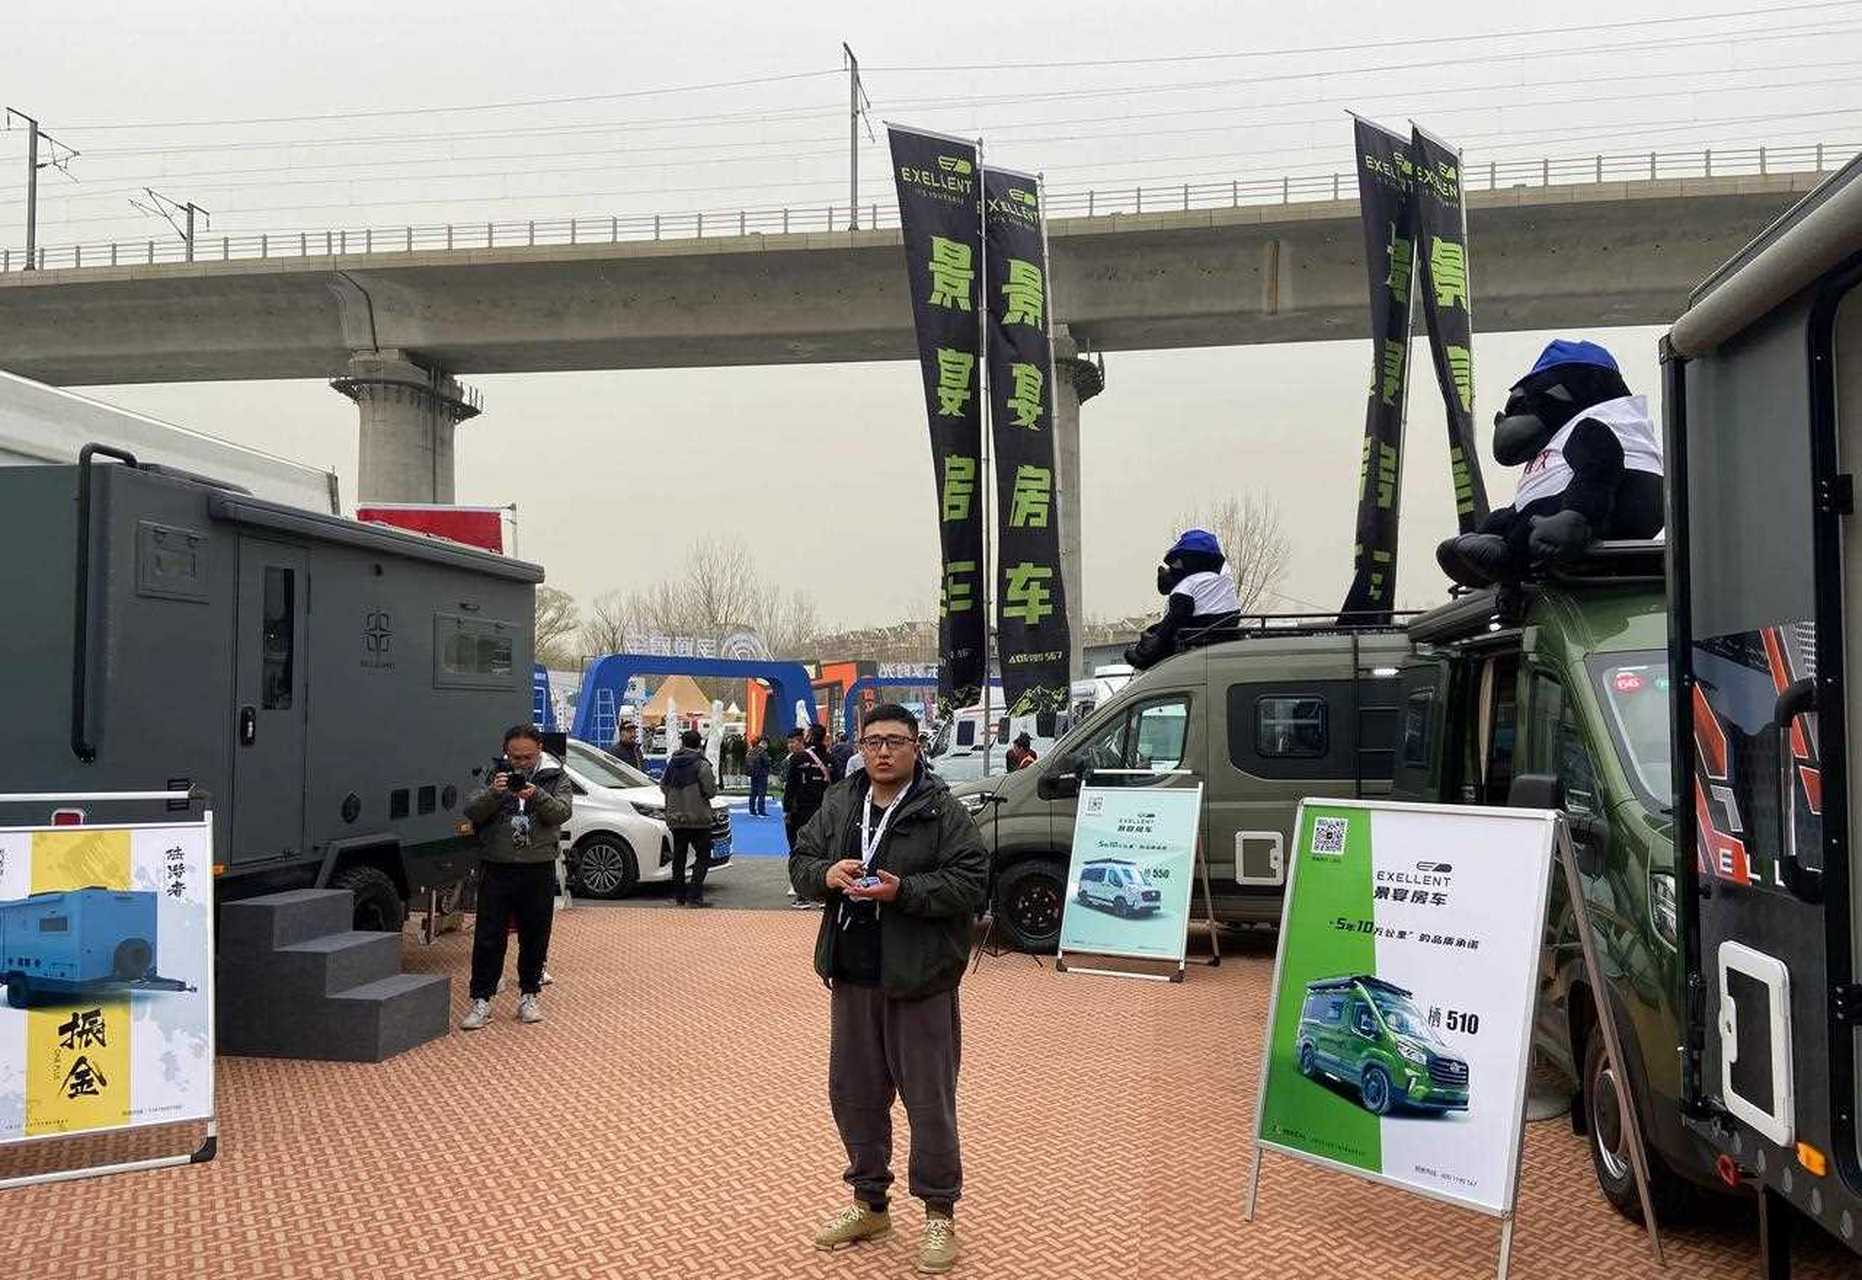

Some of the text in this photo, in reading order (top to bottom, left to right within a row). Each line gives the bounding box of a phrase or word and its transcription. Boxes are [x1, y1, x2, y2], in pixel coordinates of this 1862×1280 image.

[901, 167, 972, 193] EXELLENT
[1001, 258, 1053, 626] 景宴房车
[1376, 870, 1451, 887] EXELLENT
[1373, 886, 1447, 906] 景宴房车
[1446, 1010, 1479, 1035] 510
[57, 1007, 108, 1099] 振金
